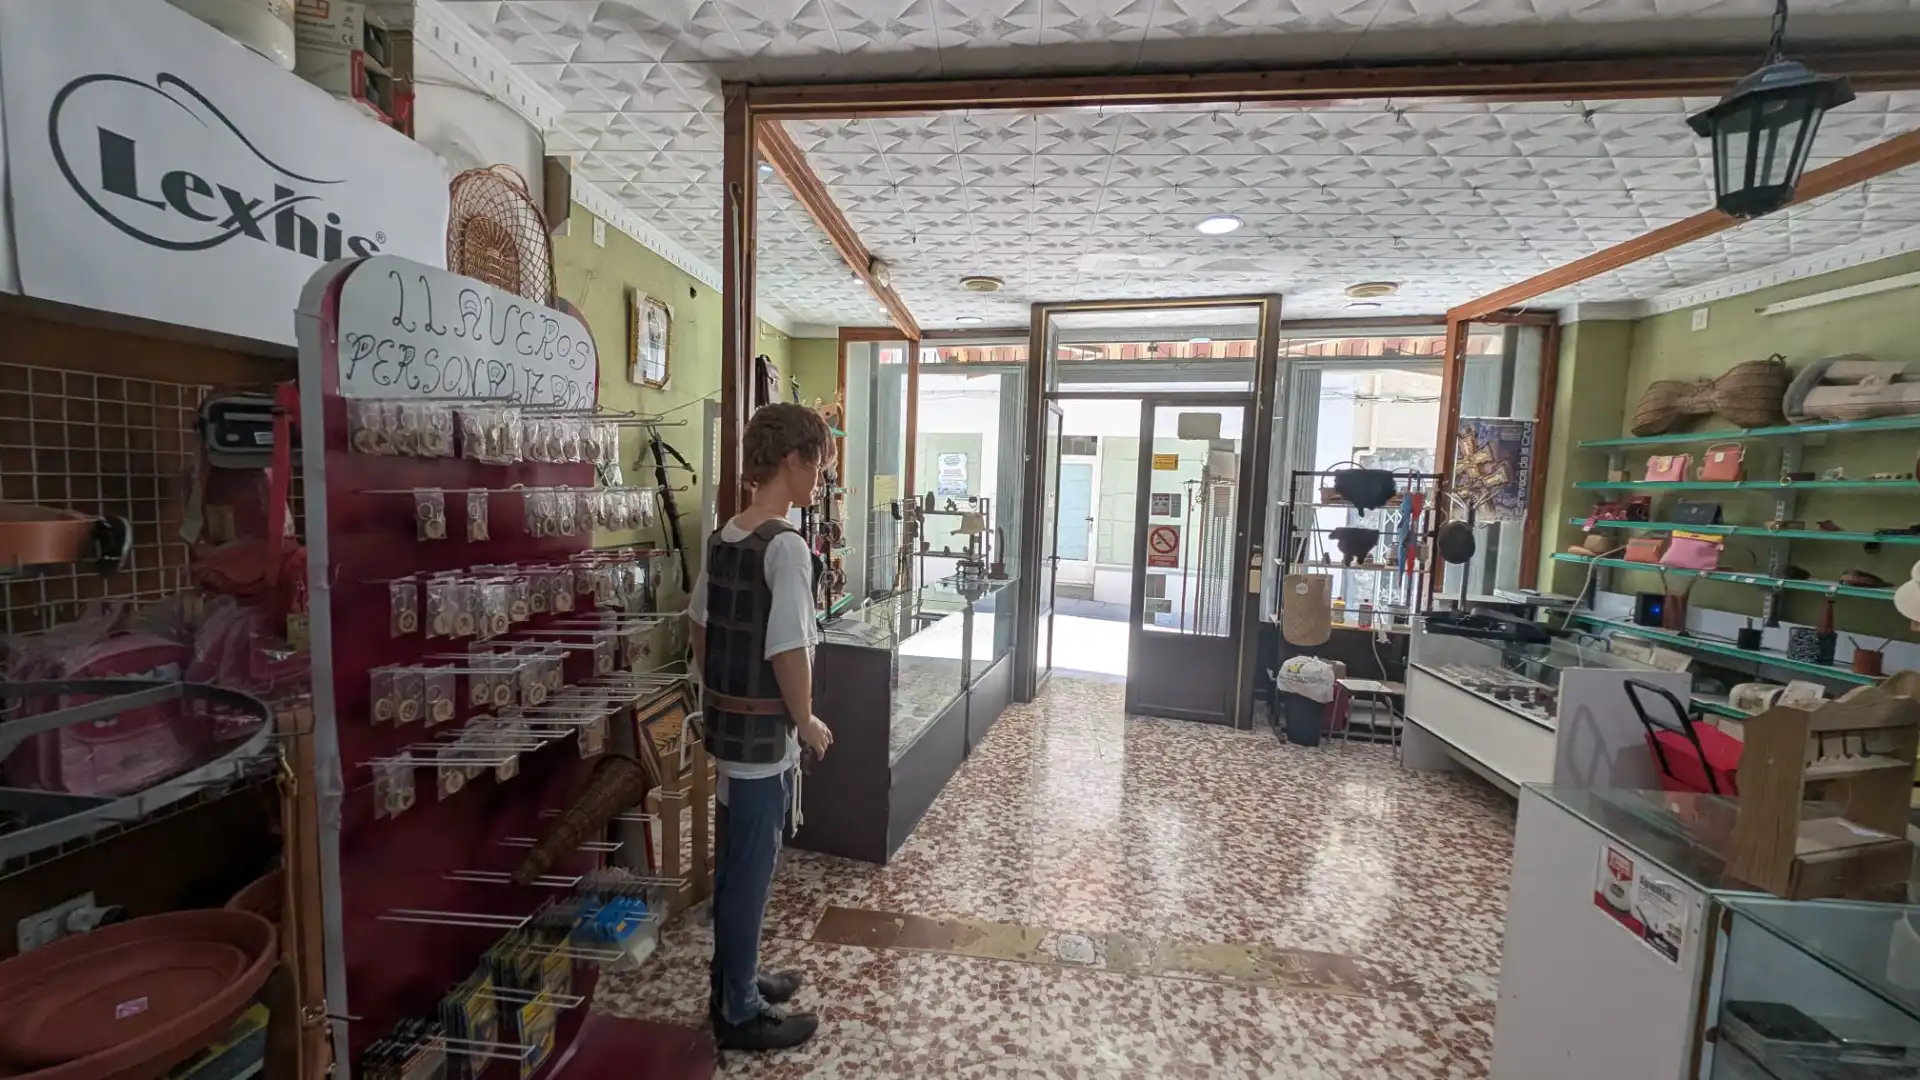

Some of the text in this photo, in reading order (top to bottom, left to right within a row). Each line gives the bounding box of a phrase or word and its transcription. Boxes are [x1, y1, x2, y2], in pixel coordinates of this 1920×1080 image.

[97, 126, 380, 262] Lexhis
[389, 270, 590, 370] LLAVEROS
[1515, 470, 1528, 516] Caravaca
[1522, 422, 1532, 446] Cruz
